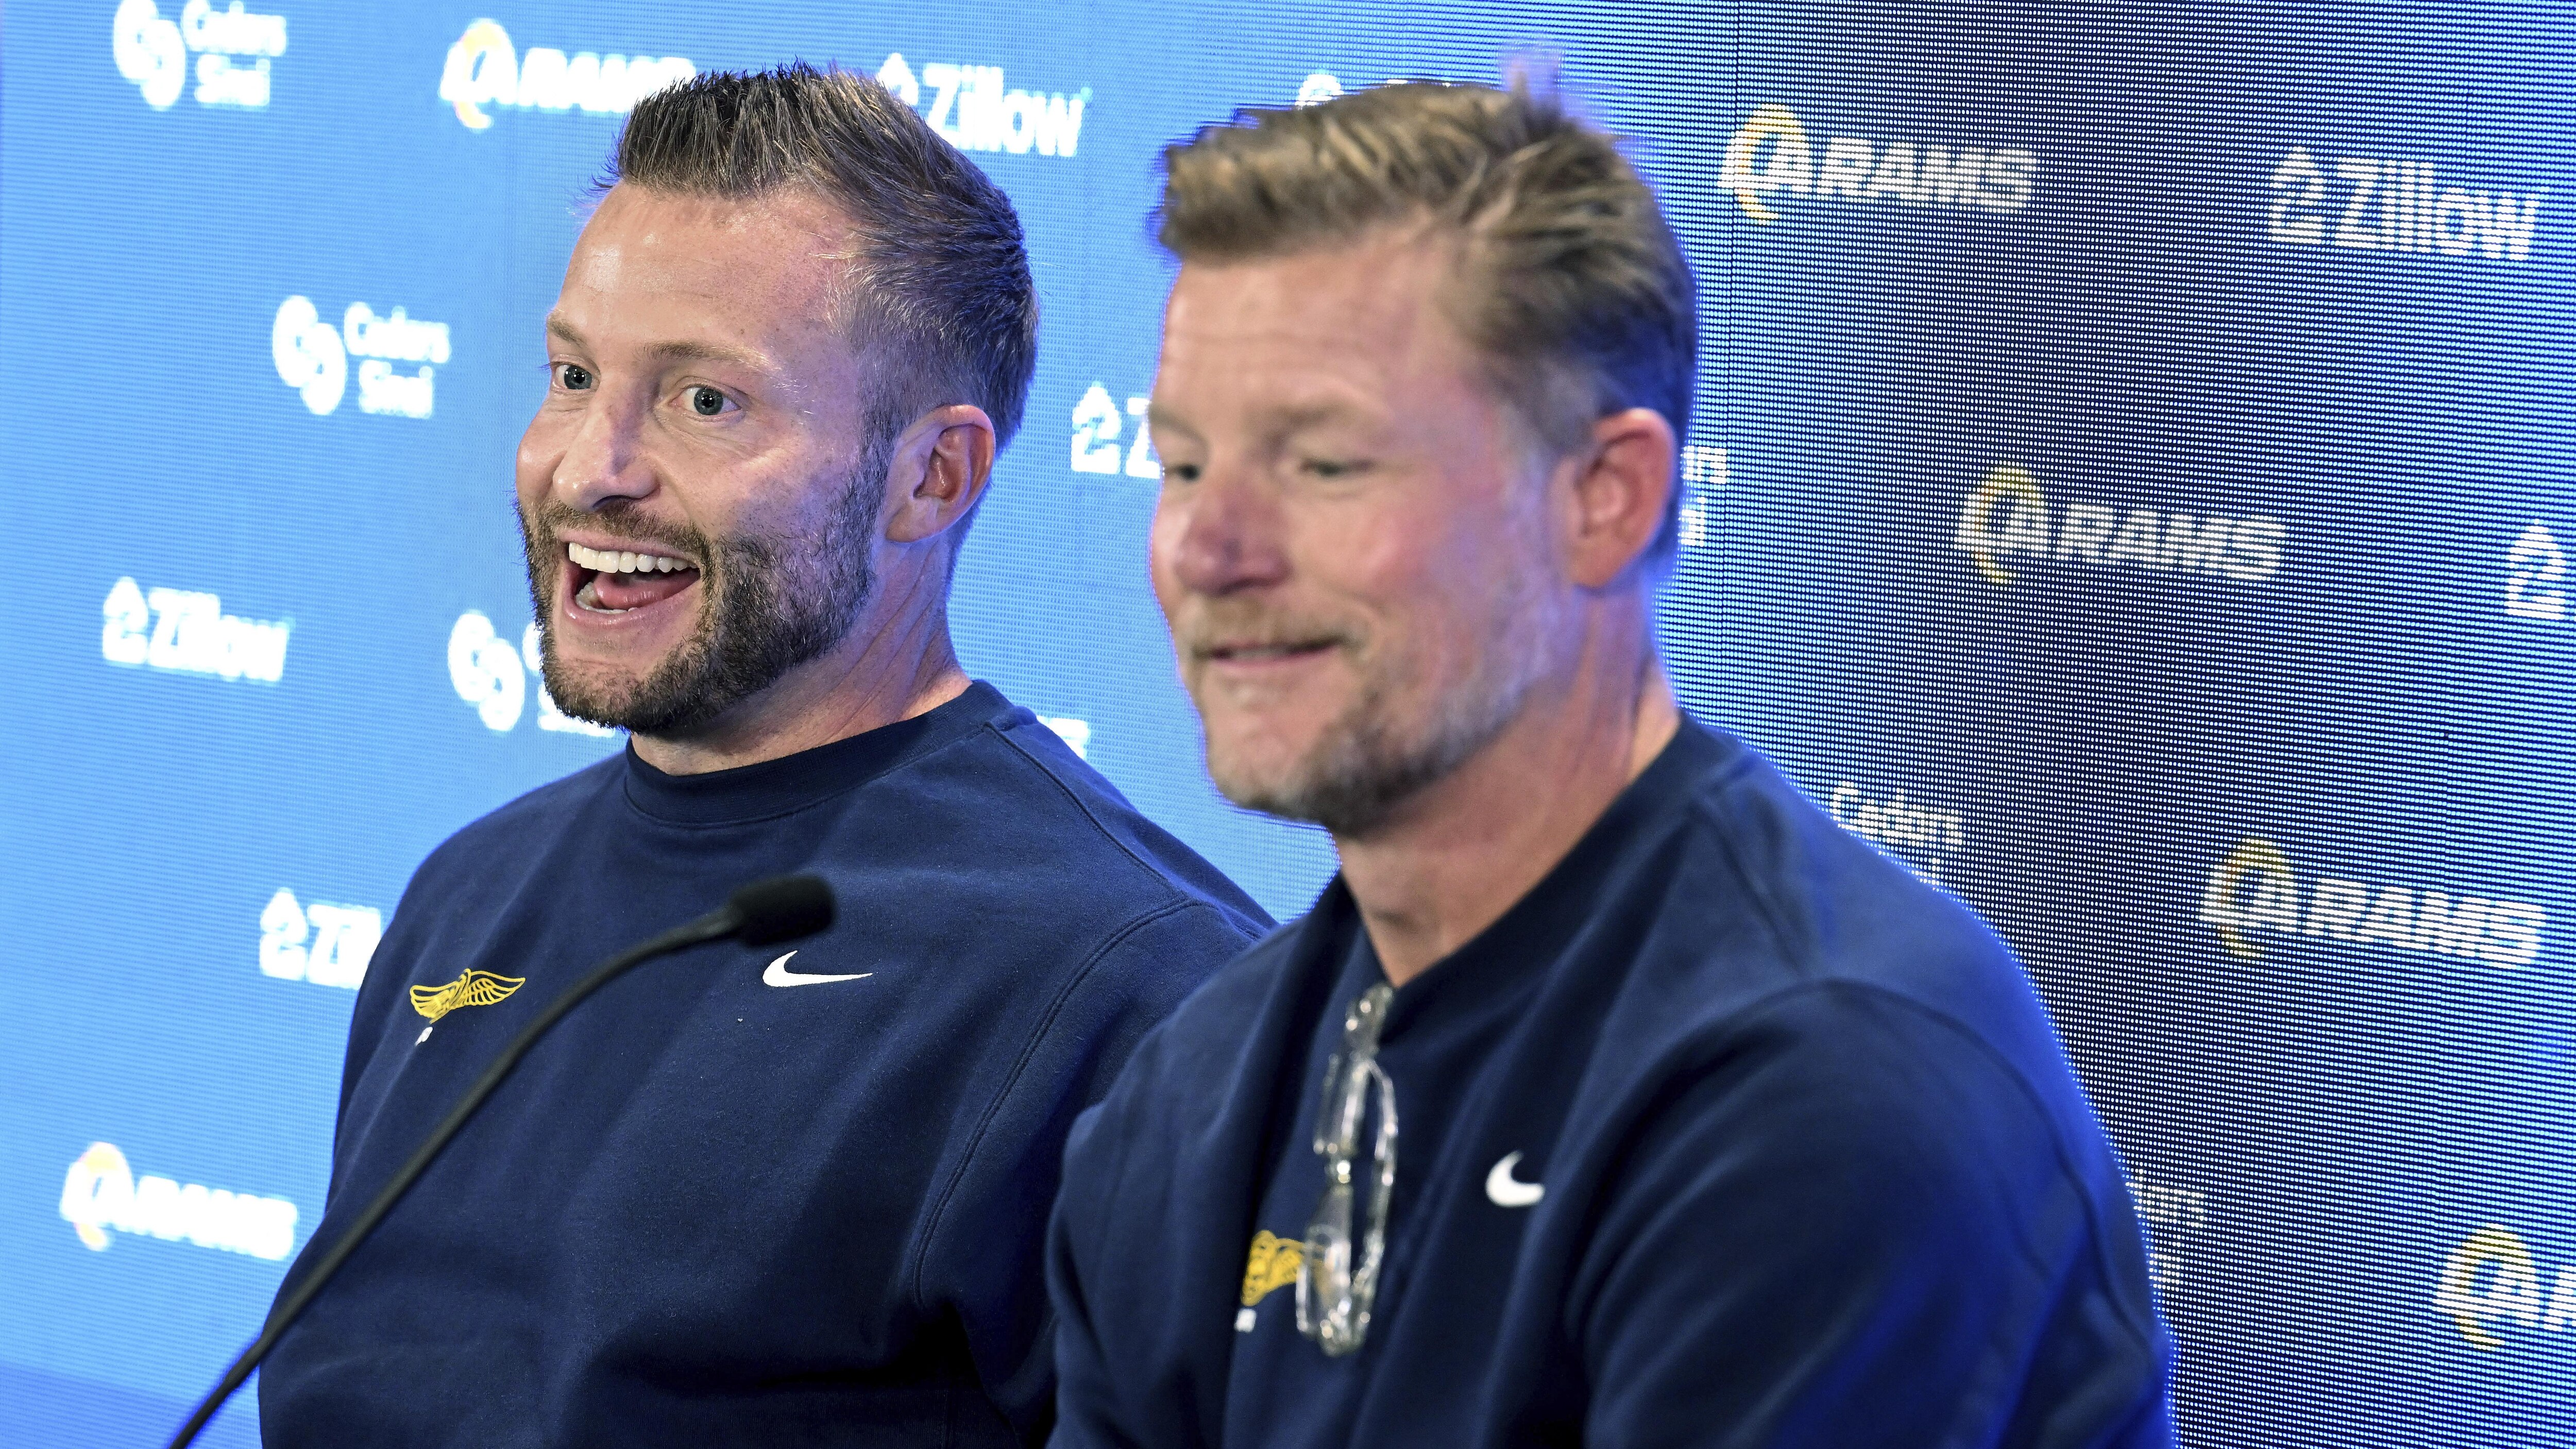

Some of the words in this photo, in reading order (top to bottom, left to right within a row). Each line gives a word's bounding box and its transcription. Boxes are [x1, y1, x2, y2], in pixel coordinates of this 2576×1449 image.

[922, 62, 1086, 158] Zillow
[1816, 137, 2038, 213] RAMS
[2335, 156, 2538, 260] Zillow
[2057, 502, 2286, 582] RAMS
[147, 586, 290, 685] Zillow
[306, 902, 381, 990] Zill
[2306, 877, 2547, 970] RAMS
